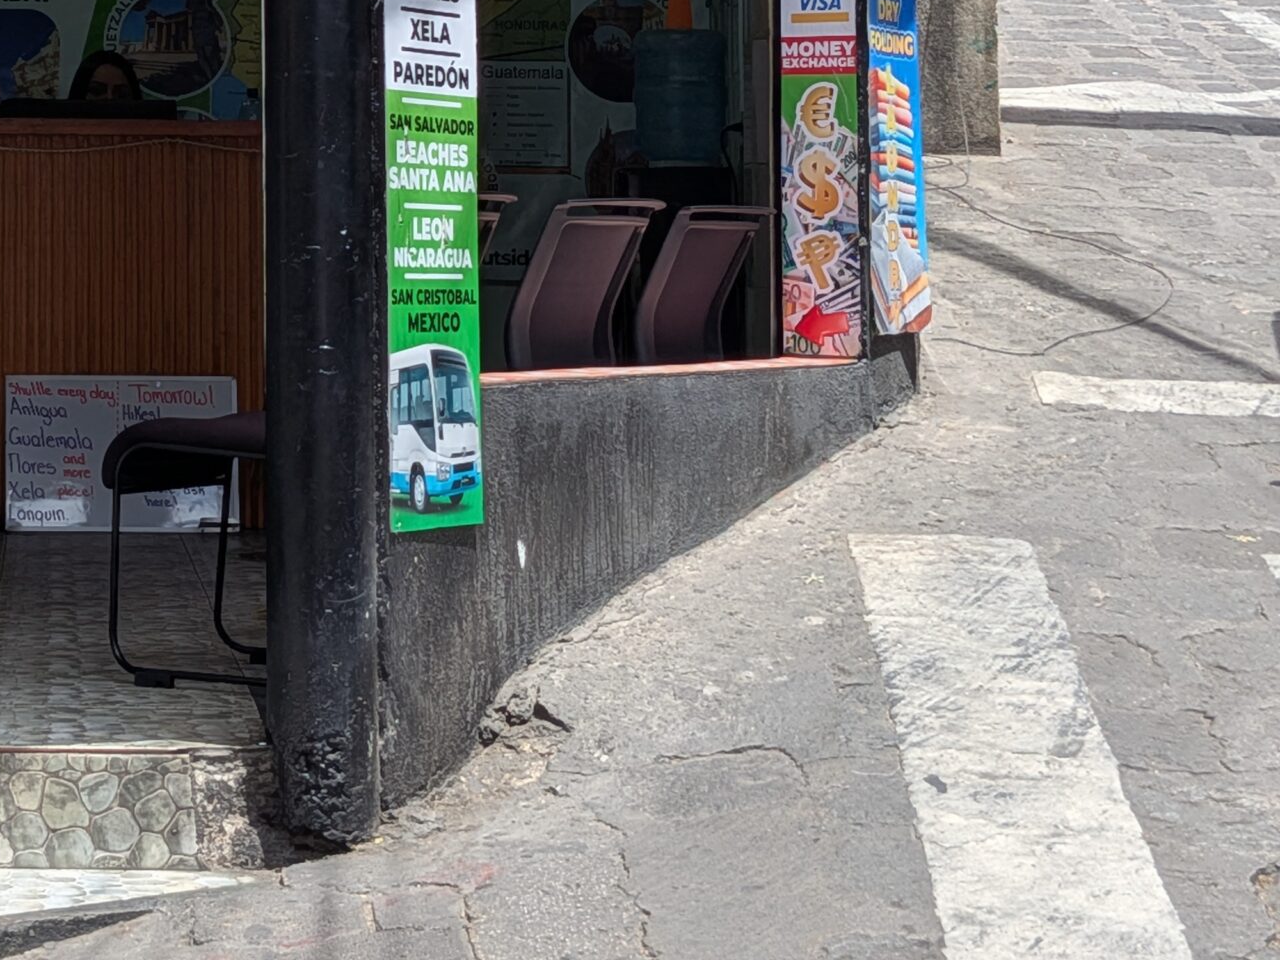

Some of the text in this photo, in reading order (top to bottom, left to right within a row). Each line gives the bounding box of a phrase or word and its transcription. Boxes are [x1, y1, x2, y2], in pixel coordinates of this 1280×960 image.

[410, 18, 451, 44] XELA
[495, 20, 567, 31] HONDURAS
[781, 41, 855, 58] MONEY
[782, 57, 855, 68] EXCHANGE
[393, 60, 469, 91] PAREDÓN
[481, 65, 564, 79] Guatemala
[128, 384, 215, 408] Tomorrow!
[10, 397, 68, 425] Antigua
[63, 453, 85, 464] and
[63, 469, 91, 478] more
[9, 481, 45, 499] Xela
